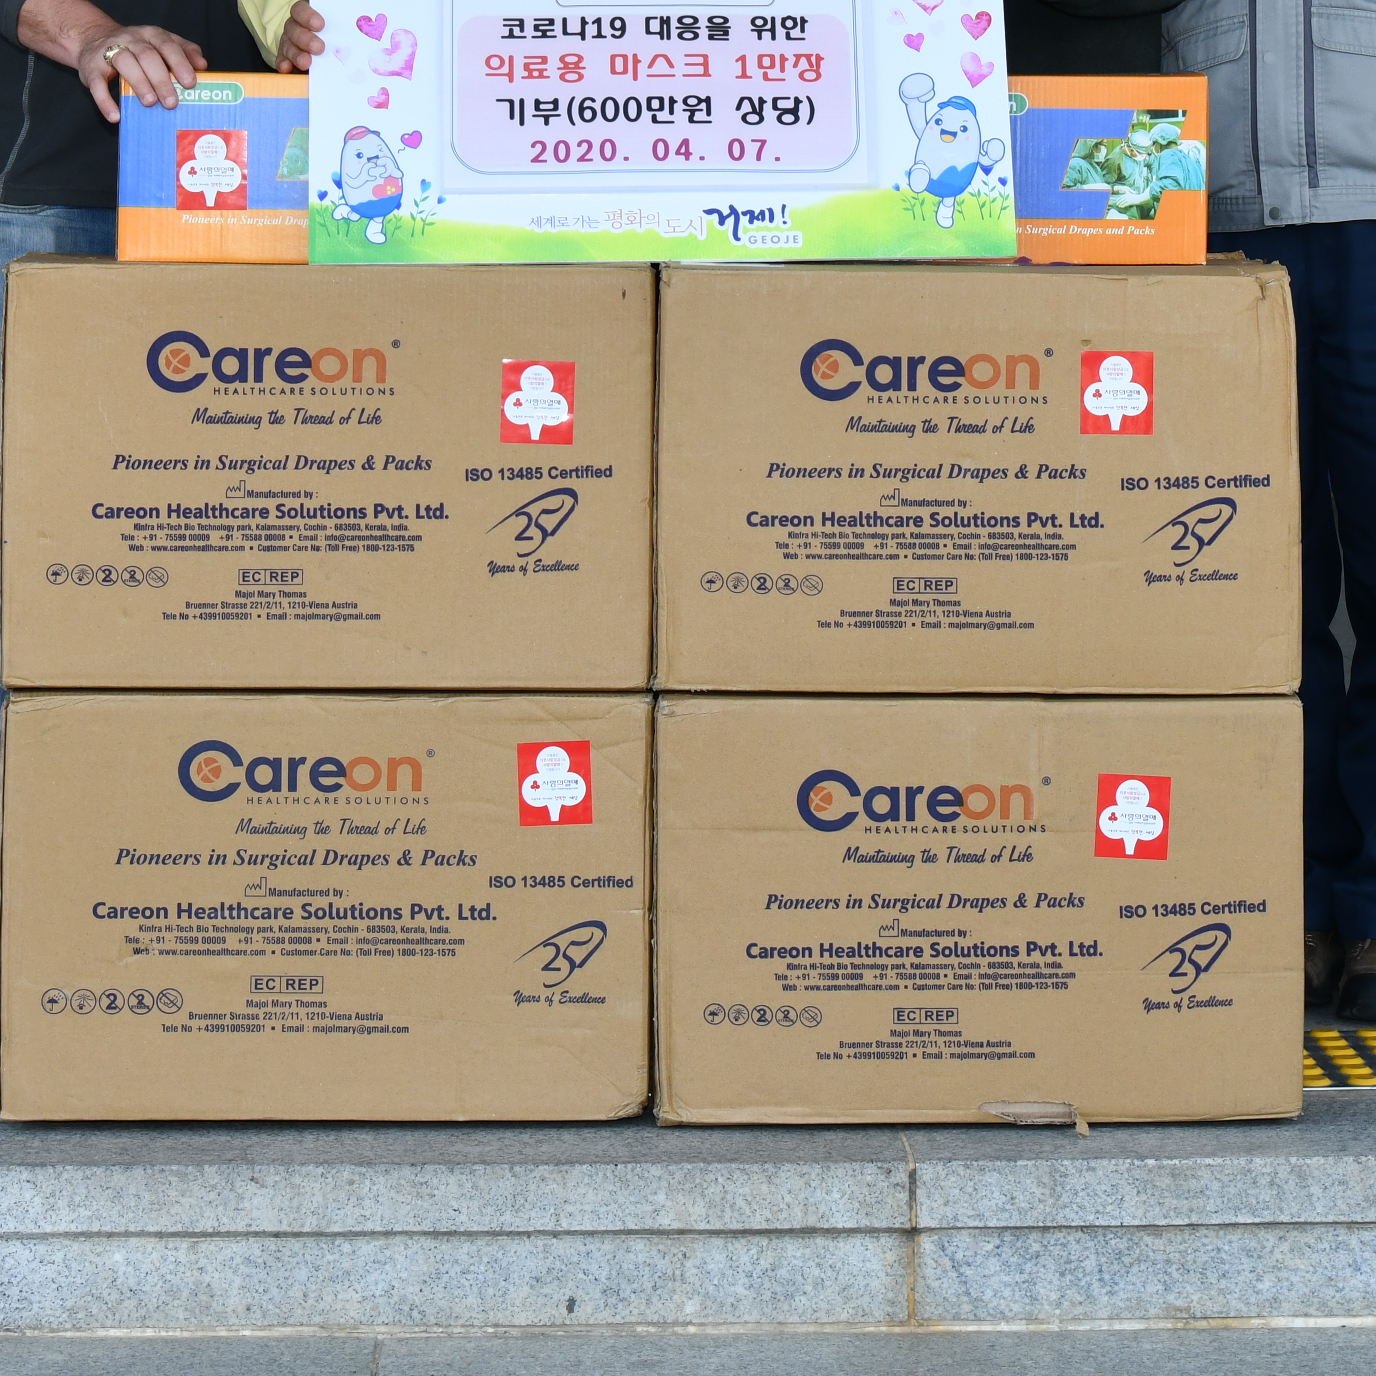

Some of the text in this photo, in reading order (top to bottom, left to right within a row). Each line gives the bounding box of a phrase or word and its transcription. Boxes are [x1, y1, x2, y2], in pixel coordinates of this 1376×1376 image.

[501, 15, 808, 41] 코로나19 대응을 위한
[485, 53, 824, 83] 의료용 마스크 1만장
[176, 84, 232, 101] areon
[496, 95, 815, 126] 기부(600만원 상당)
[531, 138, 780, 163] 2020. 04. 07.
[181, 214, 224, 224] Pioneers
[228, 215, 238, 224] in
[240, 215, 282, 226] Surgical
[1025, 224, 1066, 236] Surgical
[1069, 225, 1103, 236] Drapes
[1106, 226, 1124, 235] and
[1127, 226, 1155, 235] Packs
[748, 235, 799, 244] GEOJE
[147, 331, 391, 394] Careon
[800, 339, 1039, 404] Careon
[466, 465, 612, 481] ISO 13485 Certified
[1121, 474, 1270, 491] ISO 13485 Certified
[92, 503, 449, 519] Careon Healthcare Solutions Pvt. Ltd.
[746, 511, 1104, 528] Careon Healthcare Solutions Pvt. Ltd.
[178, 740, 421, 804] Careon
[797, 770, 1035, 834] Careon
[489, 876, 633, 888] ISO 13485 Certified
[93, 902, 497, 920] Careon Healthcare Solutions Pvt. Ltd.
[1120, 899, 1266, 918] ISO 13485 Certified
[139, 924, 162, 932] Kinfra
[197, 925, 209, 933] Bio
[211, 925, 254, 935] Technology
[257, 925, 275, 935] park,
[279, 925, 330, 935] Kalamassery,
[333, 925, 358, 933] Cochin
[367, 925, 397, 934] 683503,
[401, 925, 427, 934] Kerala,
[430, 925, 450, 934] India.
[124, 936, 140, 944] Tele
[149, 936, 164, 944] +91
[174, 936, 196, 944] 75599
[199, 936, 226, 944] 00009
[238, 936, 252, 944] +91
[288, 936, 312, 944] 00008
[356, 937, 465, 946] info@careonhealthcare.com
[746, 940, 1103, 959] Careon Healthcare Solutions Pvt. Ltd.
[133, 947, 456, 958] Web www.careonhealthcare.com Customer Care No: (Toll Free) 1800-123-1575
[246, 999, 327, 1010] Majol Mary Thomas
[189, 1012, 383, 1021] Bruenner Strasse 221/2/11, 1210-Viena Austria
[162, 1024, 409, 1034] Tele No +439910059201 Email majolmary@gmail.com
